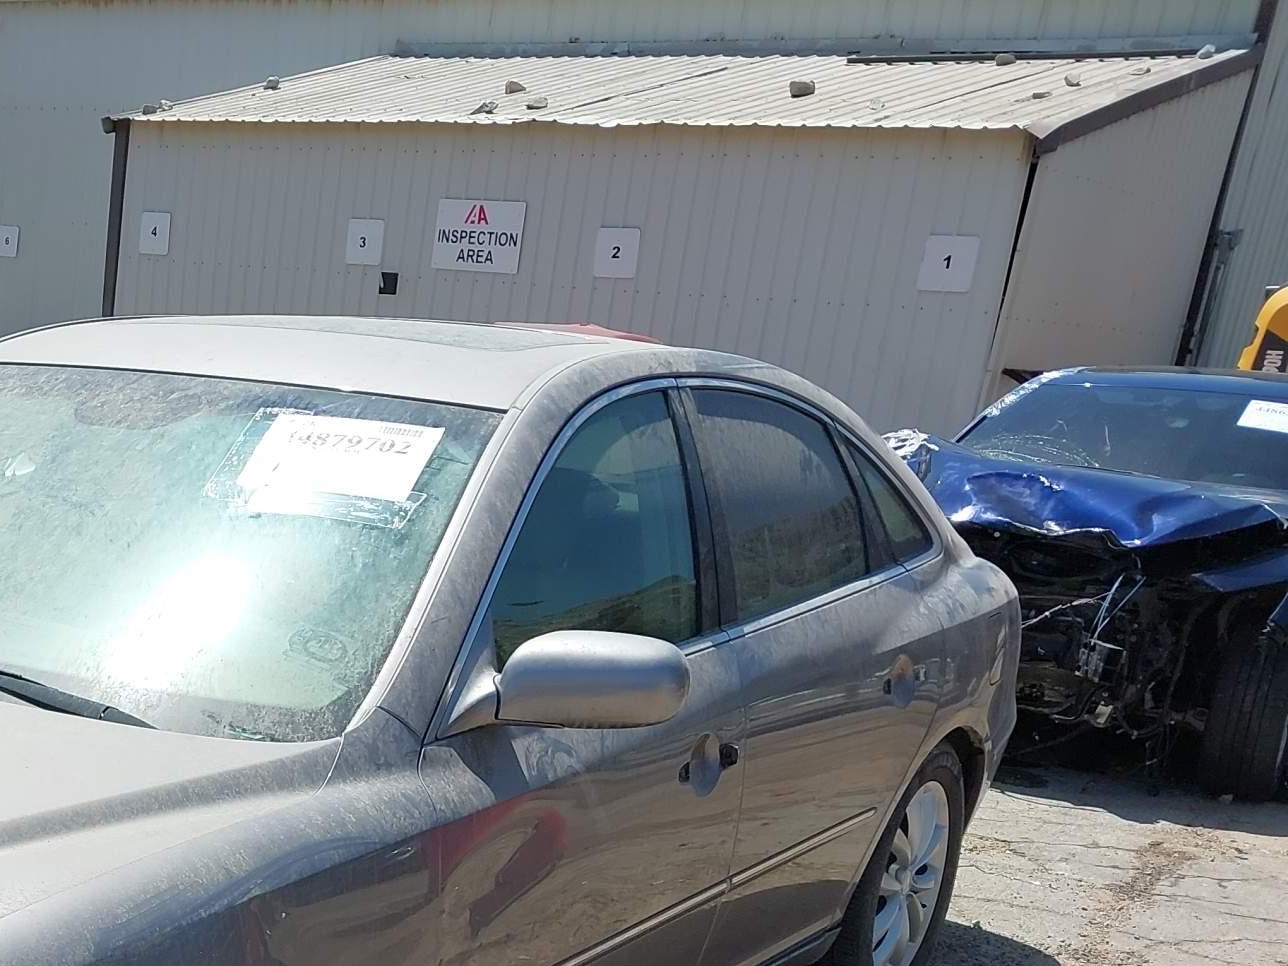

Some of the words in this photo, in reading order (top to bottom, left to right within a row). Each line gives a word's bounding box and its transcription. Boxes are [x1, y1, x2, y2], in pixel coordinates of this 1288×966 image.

[151, 226, 157, 238] 4
[437, 229, 519, 247] INSPECTION
[4, 236, 10, 246] 6
[359, 236, 367, 248] 3
[456, 248, 494, 265] AREA
[611, 246, 621, 259] 2
[943, 254, 952, 270] 1
